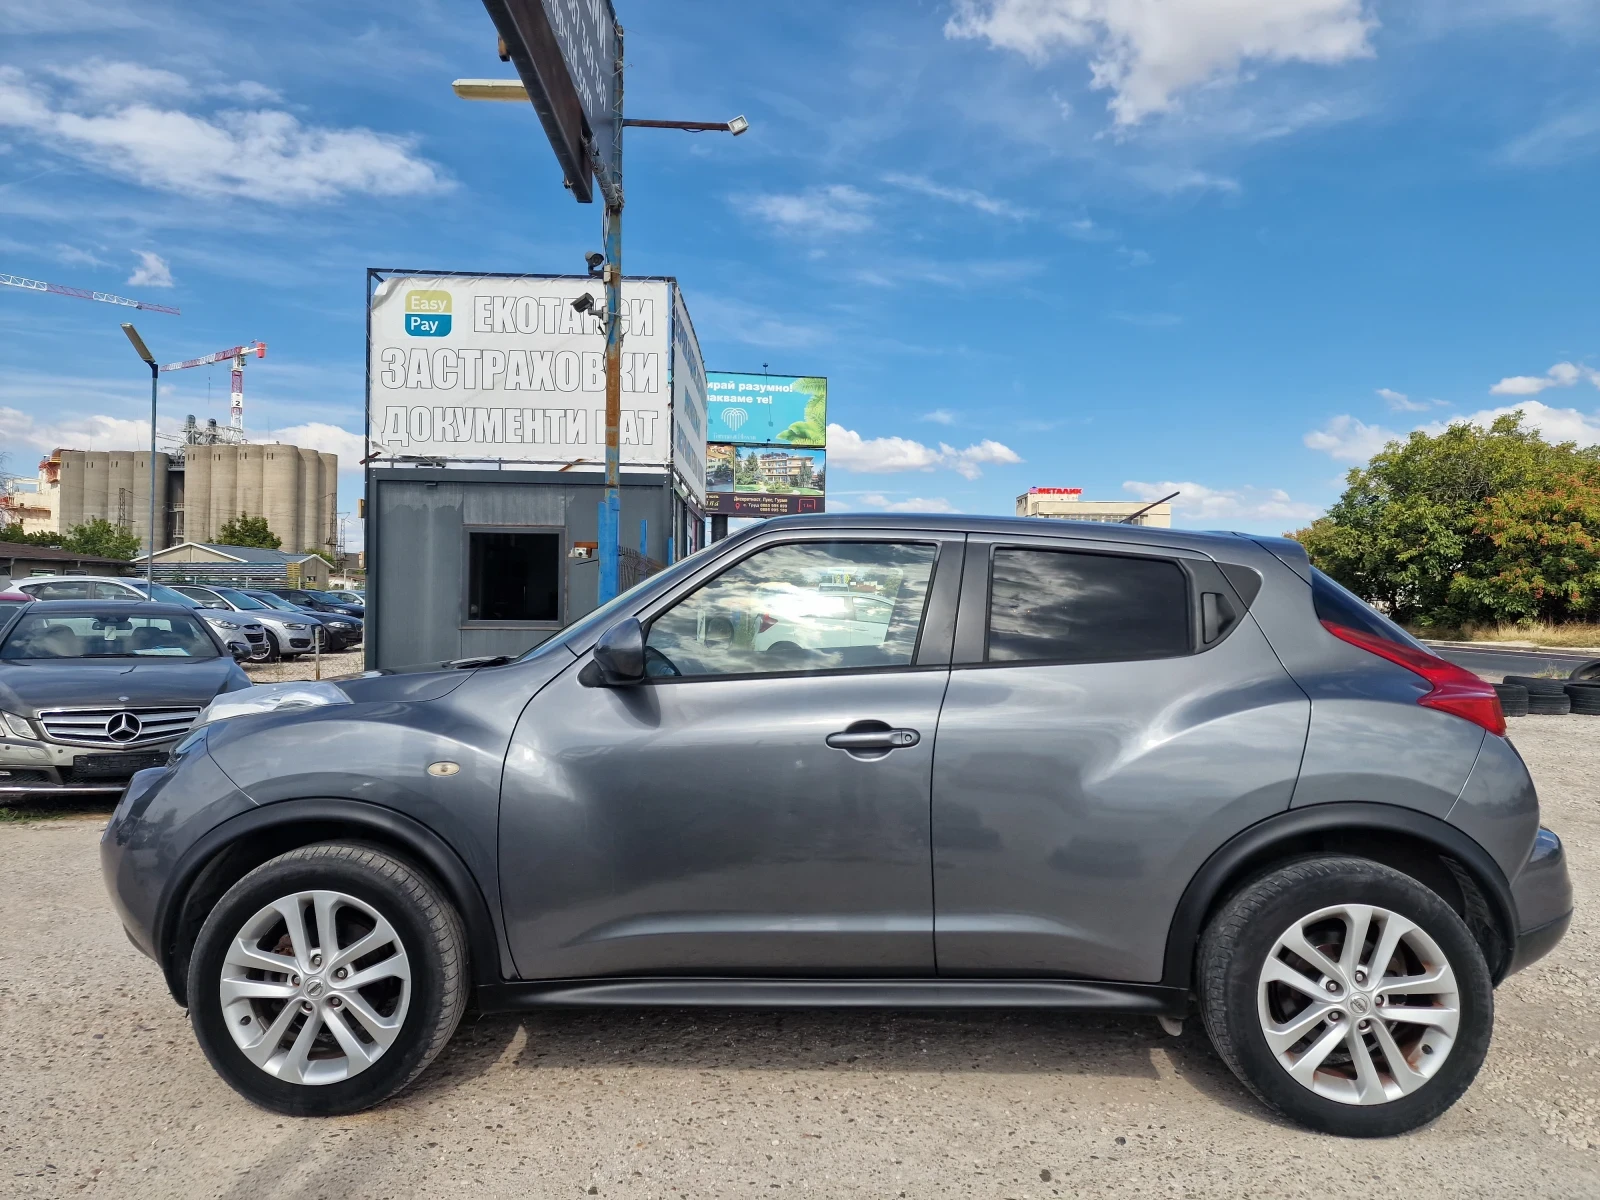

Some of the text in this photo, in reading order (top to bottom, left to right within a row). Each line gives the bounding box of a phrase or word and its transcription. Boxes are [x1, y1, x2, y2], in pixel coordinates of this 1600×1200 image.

[582, 19, 594, 76] 369
[595, 61, 607, 112] 369
[411, 295, 447, 312] Easy
[411, 316, 439, 334] Pay
[707, 381, 793, 393] ирай разумно!
[707, 394, 773, 404] акваме те!
[381, 406, 588, 447] ДОКУМЕНТИ
